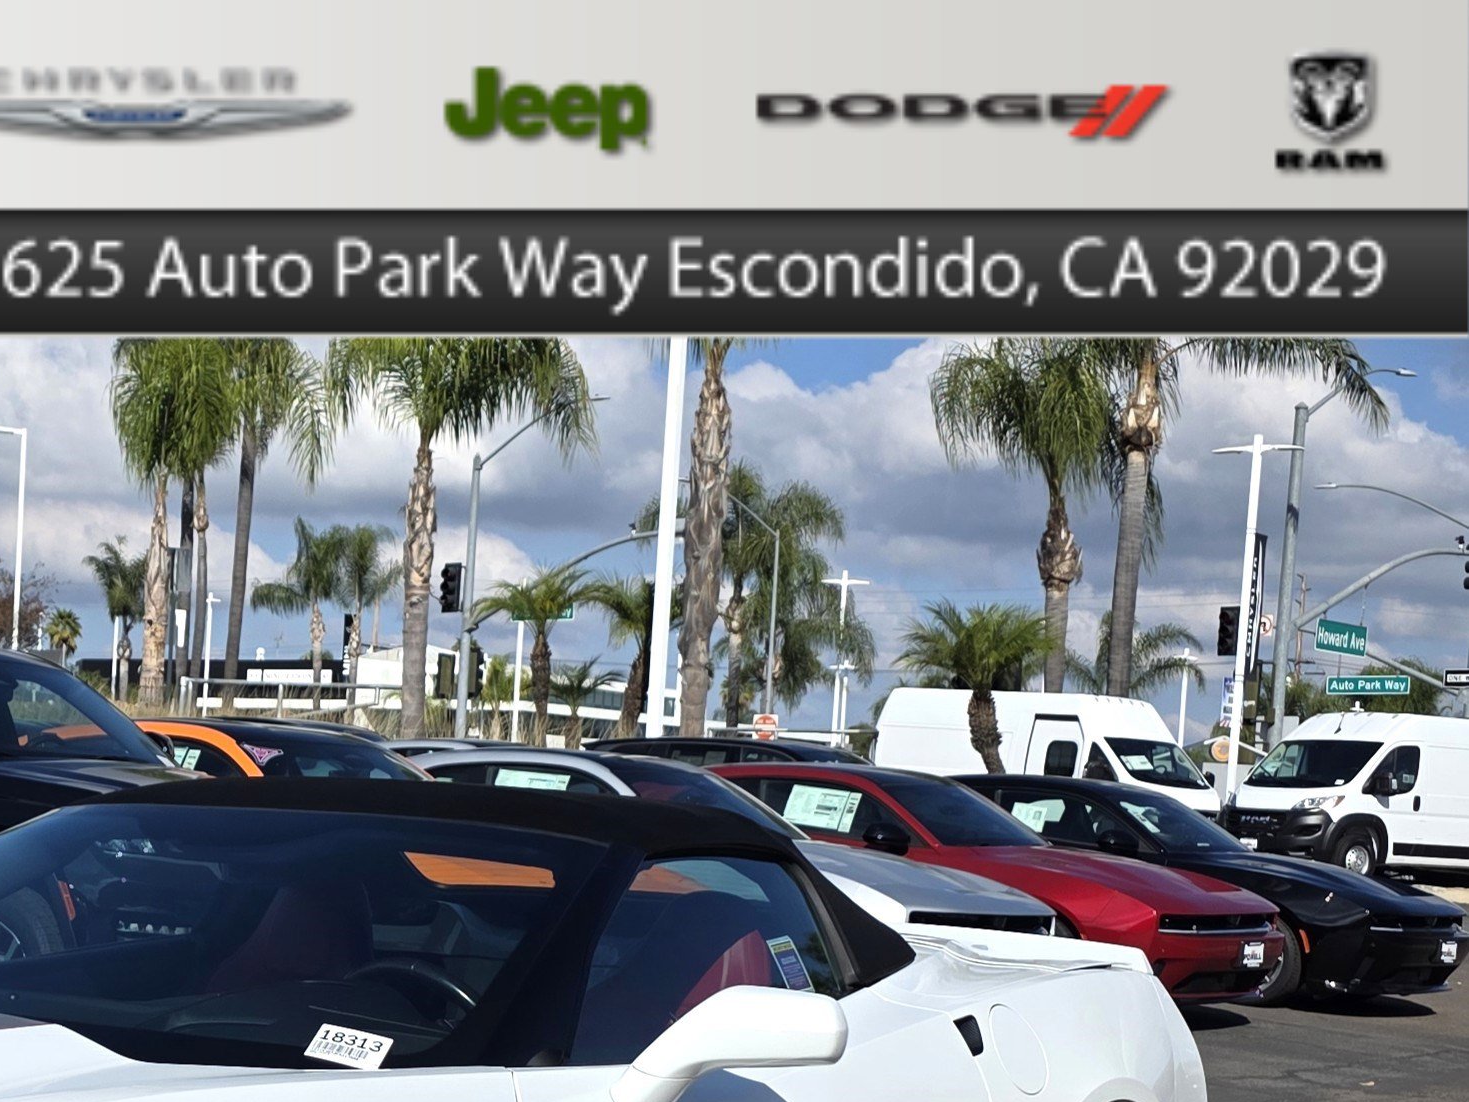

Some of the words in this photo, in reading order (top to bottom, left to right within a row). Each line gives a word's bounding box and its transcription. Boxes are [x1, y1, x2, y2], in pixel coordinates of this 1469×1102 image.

[1245, 556, 1258, 658] CHRYSLER
[1317, 626, 1349, 648] Howard
[1349, 631, 1365, 651] Ave
[1330, 679, 1355, 691] Auto
[1357, 679, 1381, 691] Park
[1384, 679, 1406, 692] Way
[320, 1029, 383, 1053] 18313
